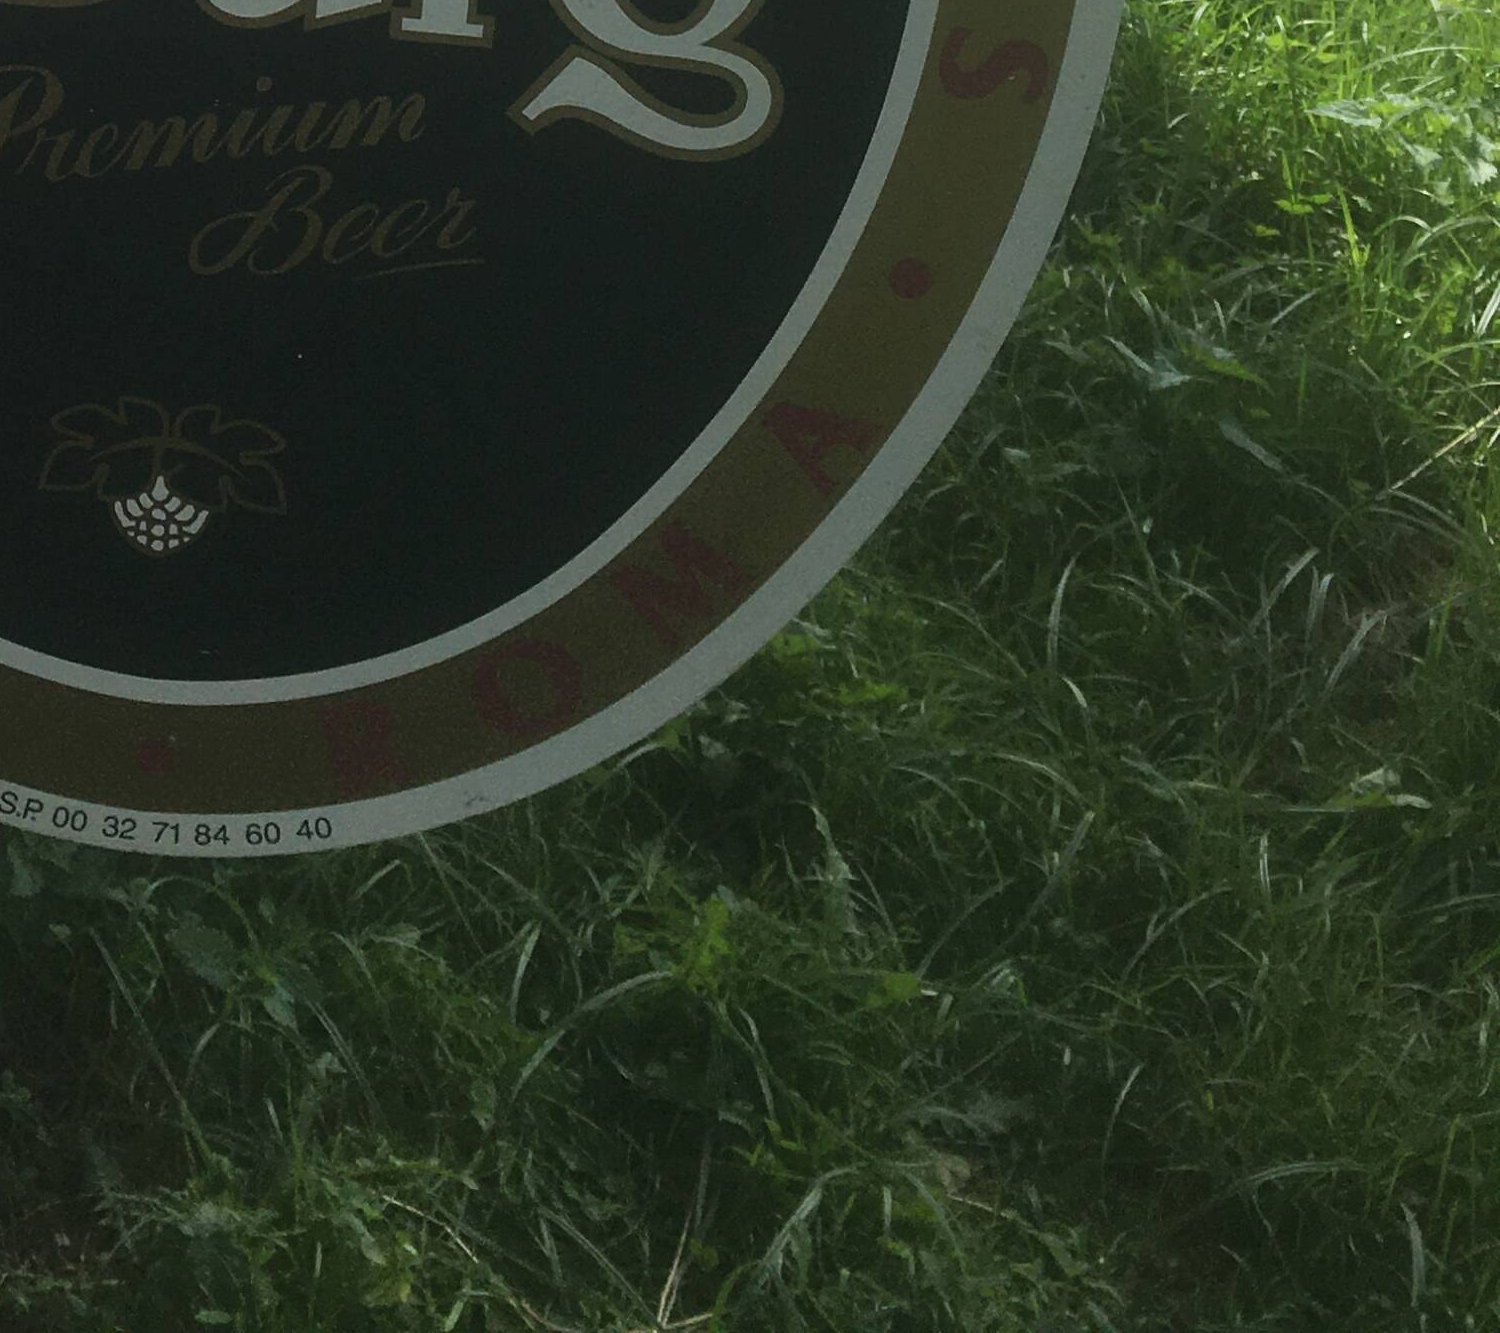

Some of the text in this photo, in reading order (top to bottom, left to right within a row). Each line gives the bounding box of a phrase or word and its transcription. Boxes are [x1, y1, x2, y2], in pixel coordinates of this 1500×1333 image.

[188, 163, 480, 277] Beer
[318, 399, 891, 798] ROMA
[51, 805, 88, 832] 00
[101, 814, 138, 842] 32
[151, 820, 181, 845] 71
[193, 823, 231, 846] 84
[244, 821, 281, 845] 60
[295, 816, 333, 841] 40
